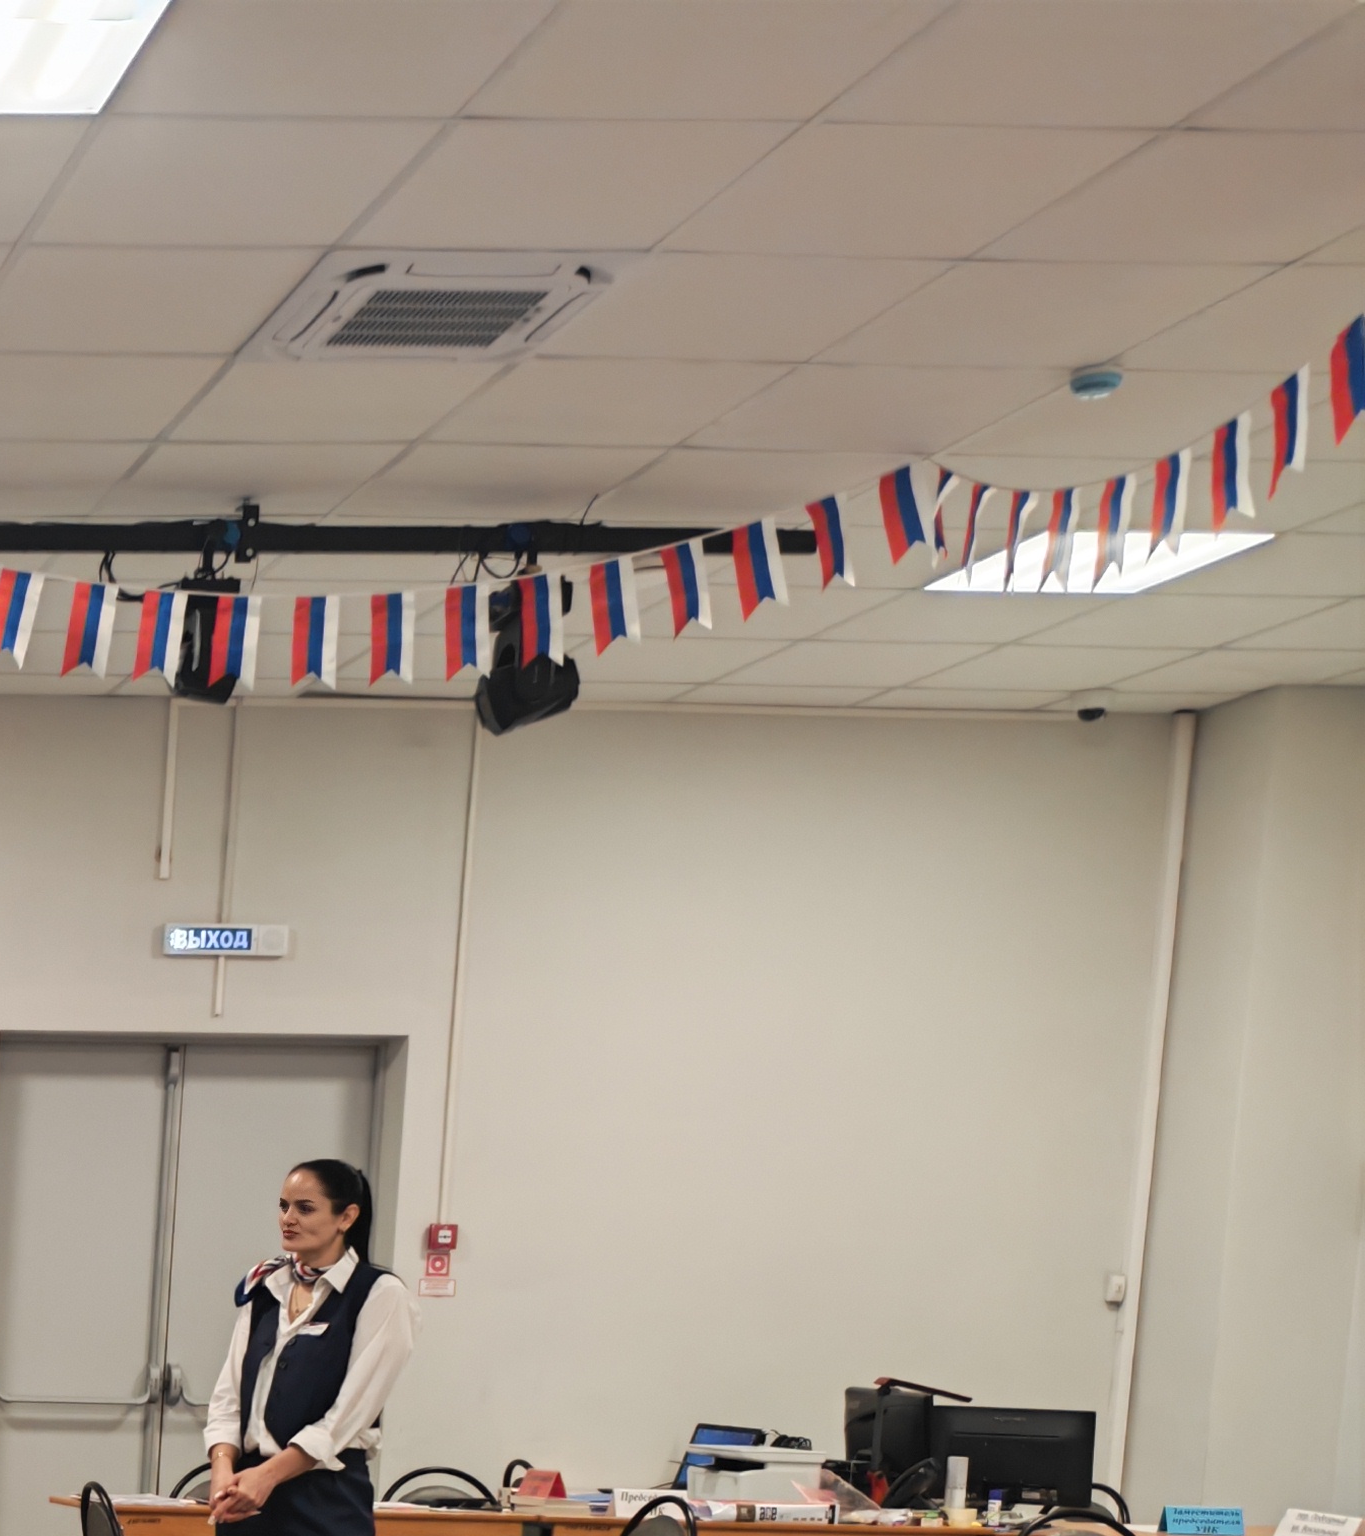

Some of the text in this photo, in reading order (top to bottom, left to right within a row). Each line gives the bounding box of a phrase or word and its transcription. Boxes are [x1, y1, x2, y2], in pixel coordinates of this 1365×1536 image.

[173, 929, 249, 950] ВЫХОД
[1173, 1507, 1240, 1517] Заместитель
[1172, 1518, 1241, 1526] председателя
[1195, 1525, 1220, 1533] УИК
